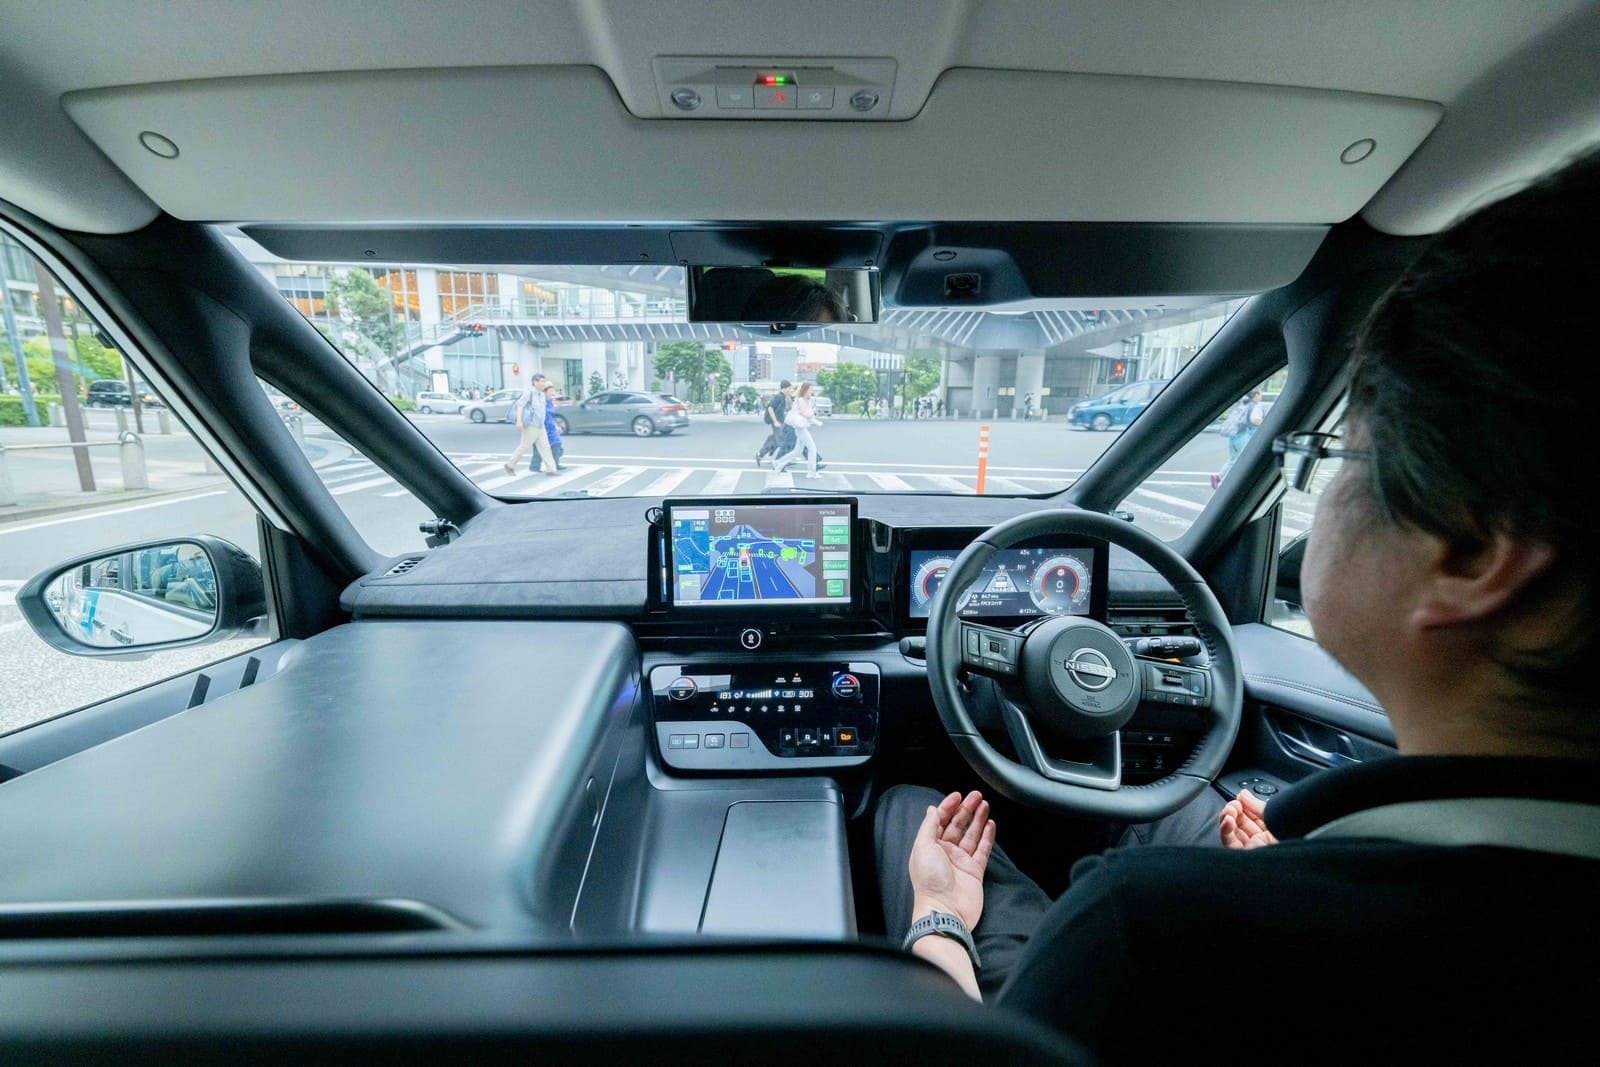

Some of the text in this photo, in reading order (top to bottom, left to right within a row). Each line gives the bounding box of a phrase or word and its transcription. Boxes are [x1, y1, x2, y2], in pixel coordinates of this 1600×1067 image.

[1056, 580, 1064, 589] 0
[1065, 661, 1116, 679] NISSAN
[823, 733, 830, 741] N
